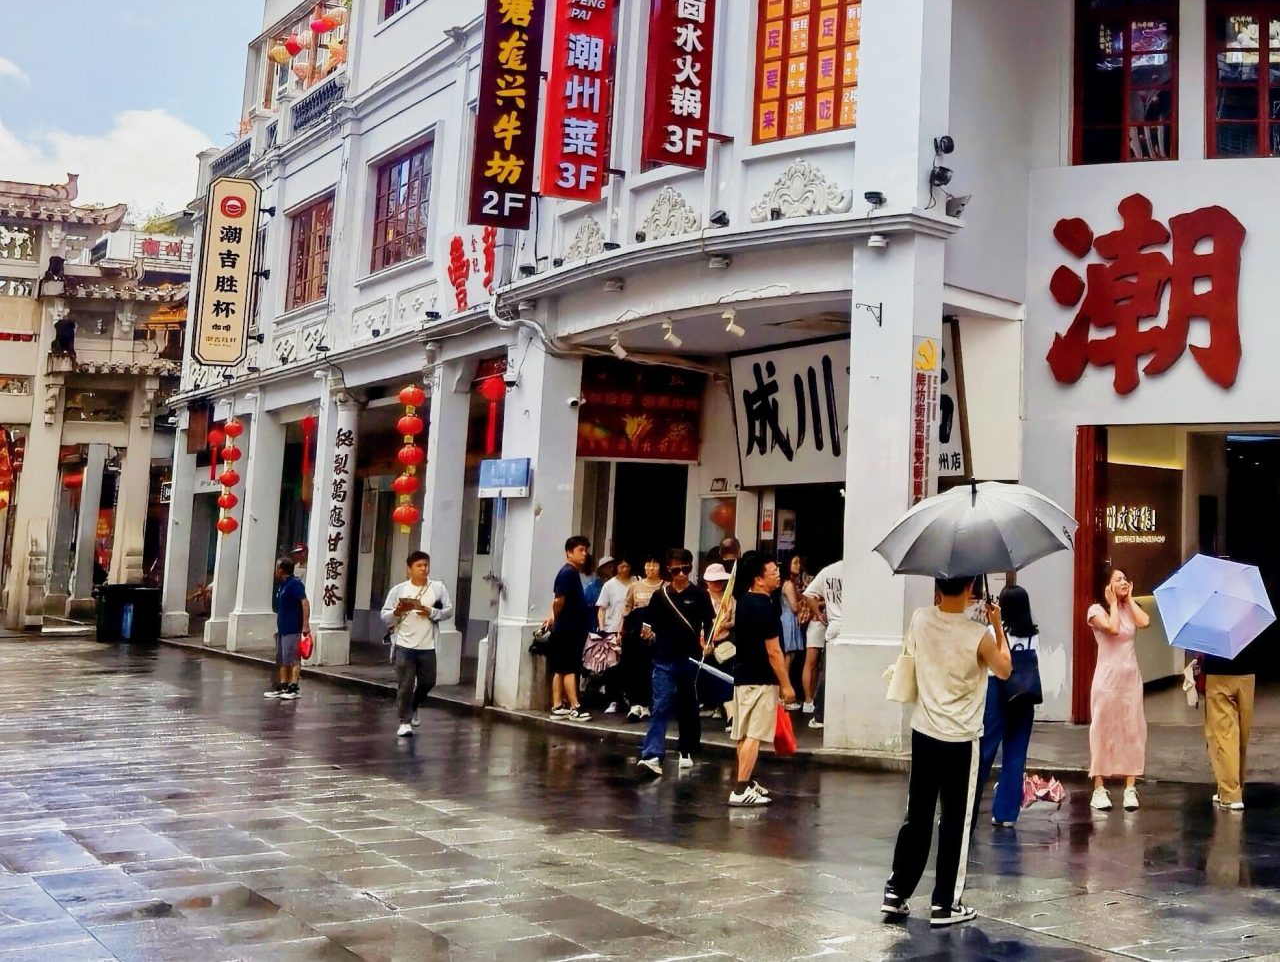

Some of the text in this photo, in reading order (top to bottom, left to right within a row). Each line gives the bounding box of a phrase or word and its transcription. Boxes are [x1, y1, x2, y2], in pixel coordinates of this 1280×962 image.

[564, 33, 603, 156] 潮州菜
[665, 125, 703, 156] 3F
[556, 162, 597, 190] 3F
[482, 191, 525, 216] 2F
[211, 225, 243, 319] 潮吉胜杯
